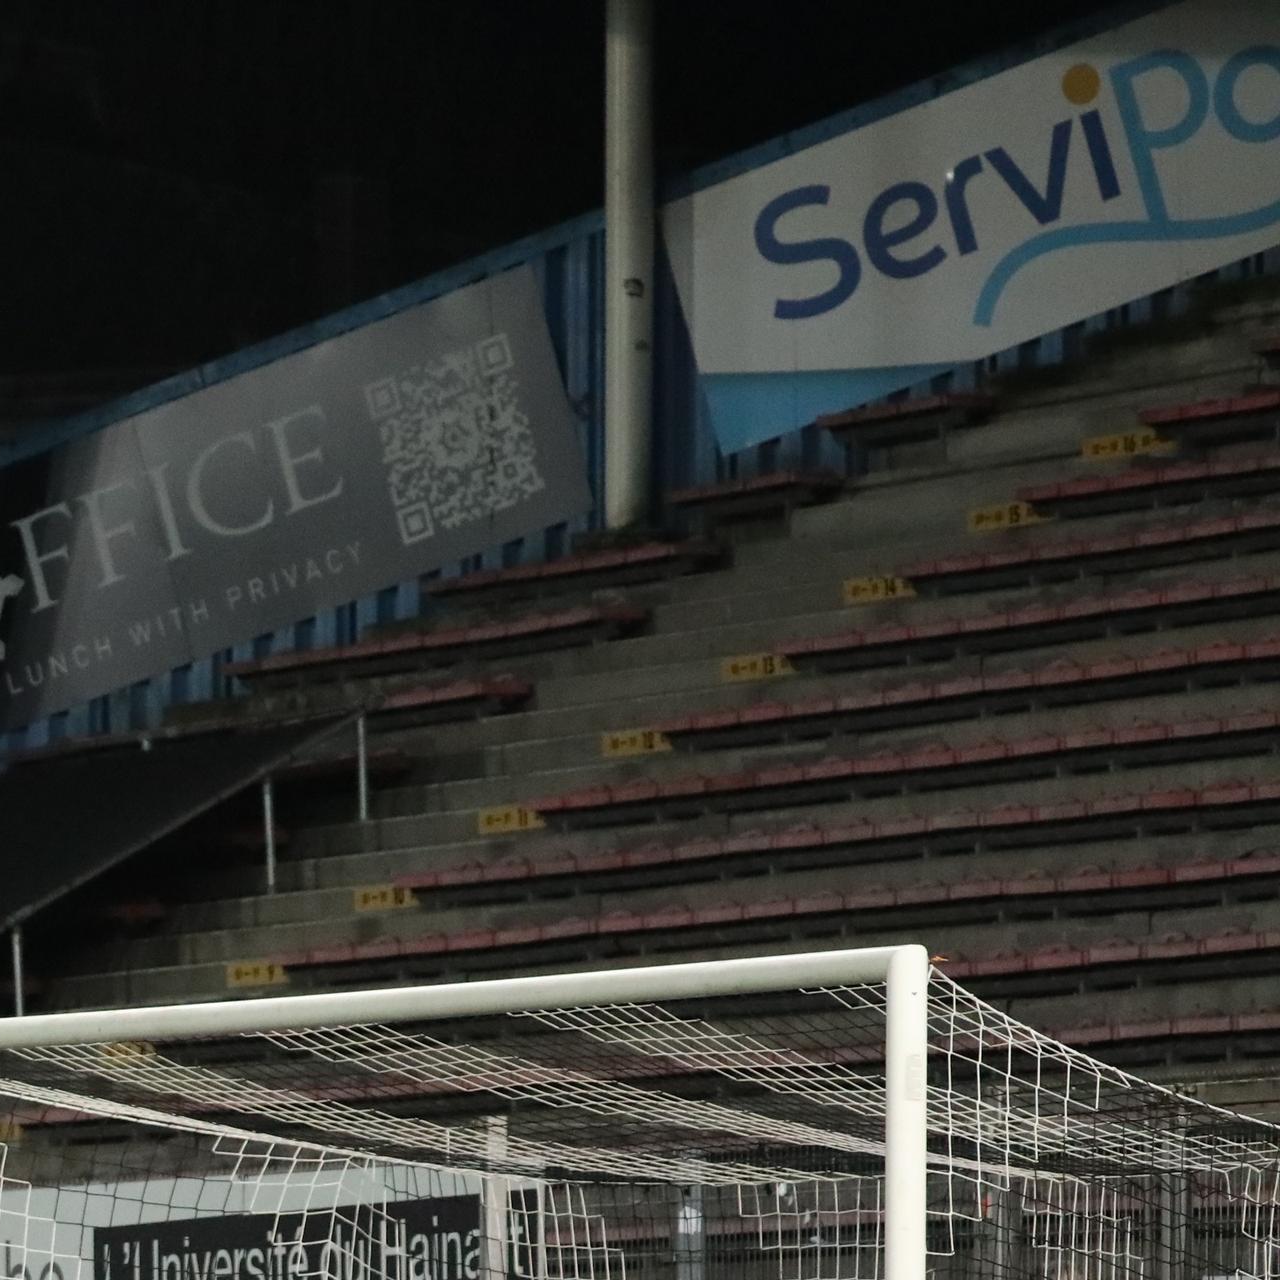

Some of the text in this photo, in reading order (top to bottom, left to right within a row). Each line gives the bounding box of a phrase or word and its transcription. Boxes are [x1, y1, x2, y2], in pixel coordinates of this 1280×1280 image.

[6, 637, 113, 697] LUNCH
[128, 599, 211, 647] WITH
[225, 541, 365, 611] PRIVACY
